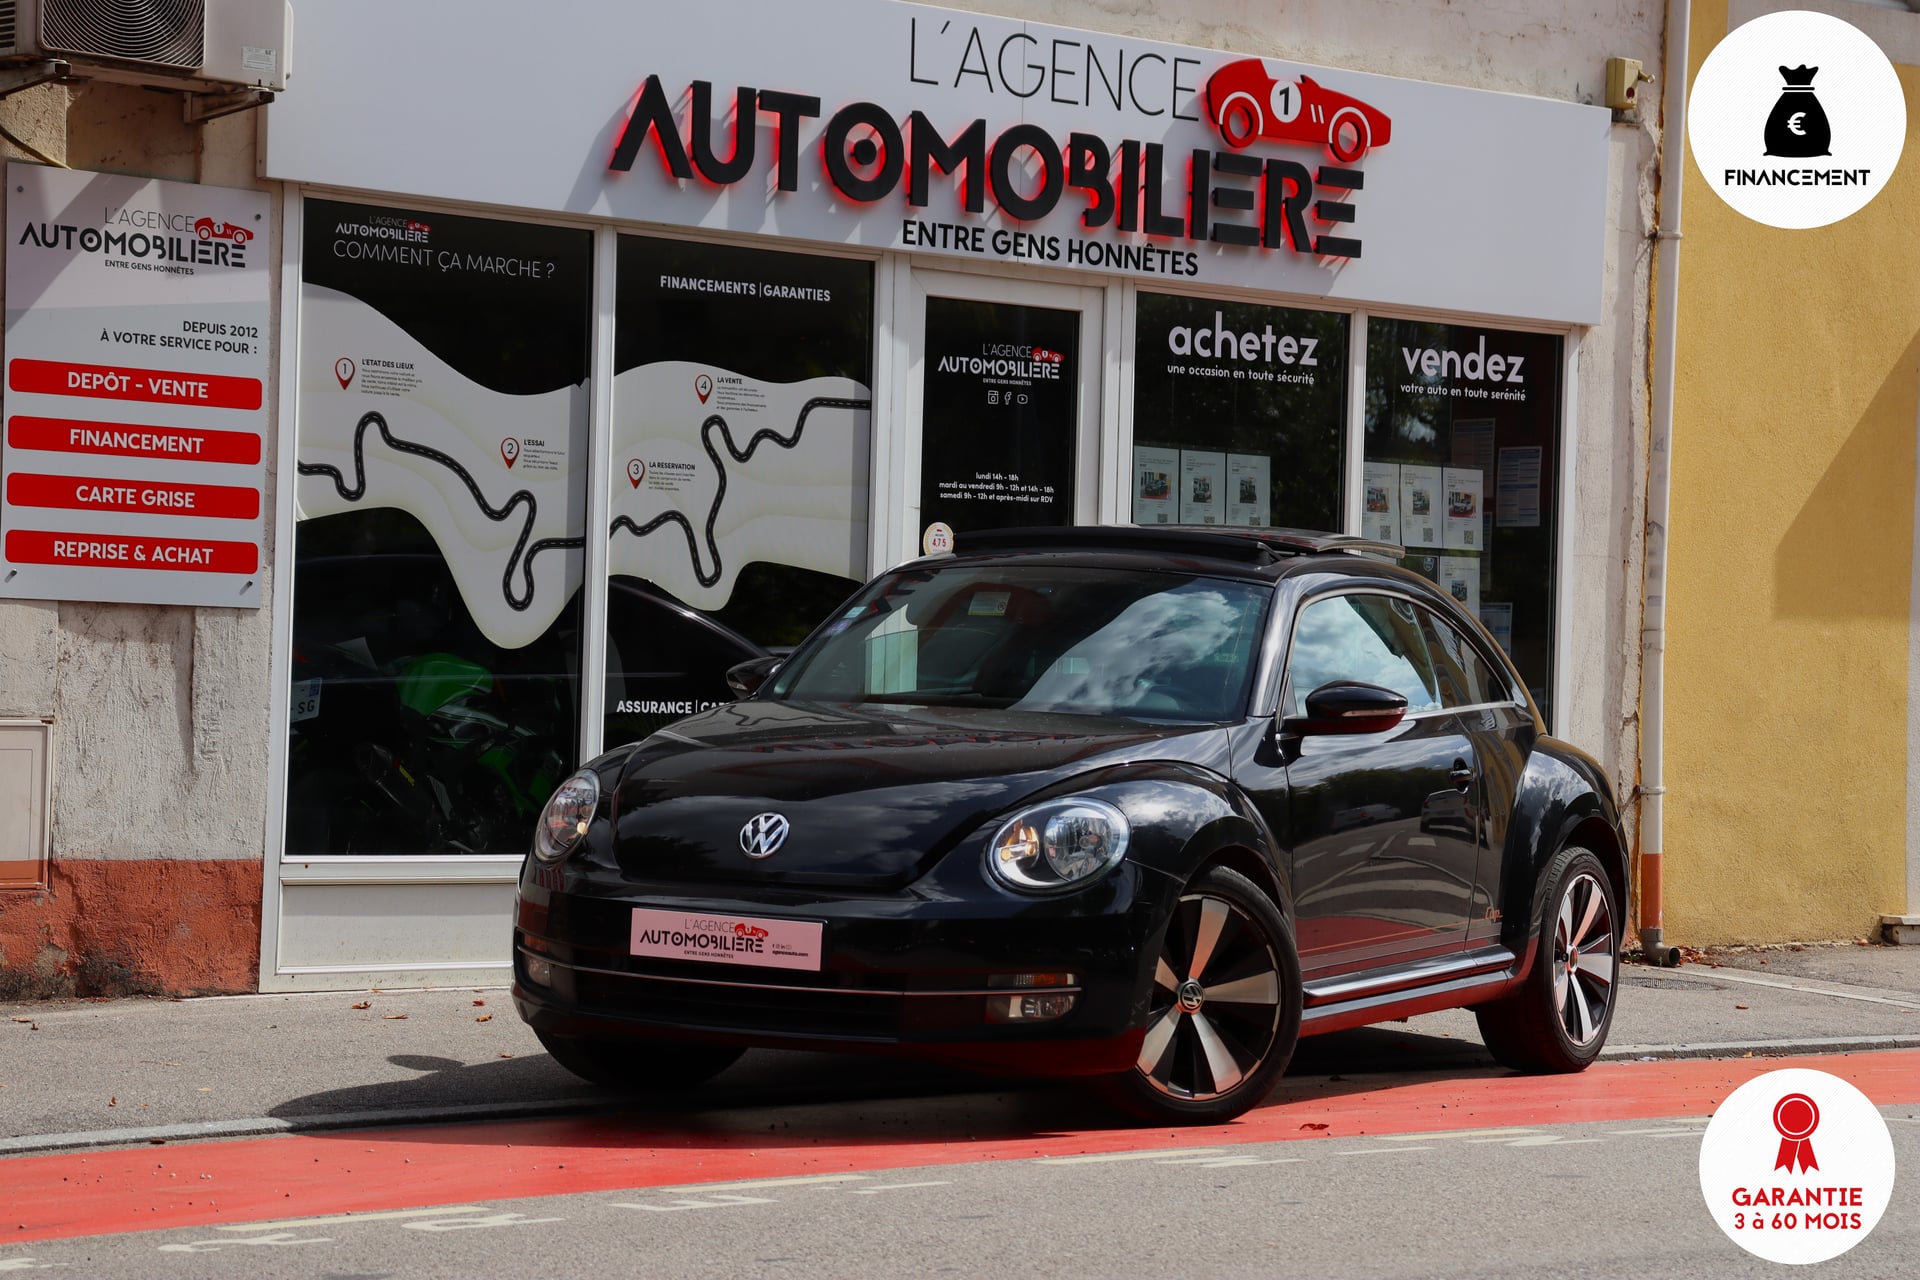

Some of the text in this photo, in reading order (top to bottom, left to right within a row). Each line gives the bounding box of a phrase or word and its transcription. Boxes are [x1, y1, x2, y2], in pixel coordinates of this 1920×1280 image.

[910, 17, 1201, 122] L'AGENCE
[1279, 86, 1290, 116] 1
[105, 206, 195, 234] L'AGENCE
[902, 219, 1199, 277] ENTRE GENS HONNÊTES
[104, 259, 194, 276] ENTRE GENS HONNÊTES
[333, 239, 555, 279] COMMENT ÇA MARCHE ?
[660, 275, 831, 302] FINANCEMENTS GARANTIES
[183, 320, 258, 339] DEPUIS 2012
[1168, 310, 1319, 367] achetez
[100, 328, 110, 342] À
[113, 331, 156, 346] VOTRE
[159, 335, 211, 351] SERVICE
[214, 339, 249, 354] POUR
[982, 343, 1032, 359] L'AGENCE
[1402, 335, 1525, 384] vendez
[342, 363, 347, 375] 1
[382, 360, 394, 368] DES
[395, 361, 414, 370] LIEUX
[724, 377, 743, 385] VENTE
[1167, 364, 1315, 386] une occasion en toute sécurité
[67, 371, 131, 392] DEPÔT
[148, 378, 209, 399] VENTE
[701, 380, 707, 390] 4
[1400, 383, 1424, 394] votre
[1427, 385, 1448, 396] auto
[1450, 388, 1461, 397] en
[1464, 386, 1488, 399] toute
[70, 428, 204, 454] FINANCEMENT
[507, 442, 514, 454] 2
[633, 463, 639, 475] 3
[657, 462, 696, 471] RESERVATION
[975, 472, 991, 480] lundi
[992, 473, 1003, 481] 14h
[939, 481, 958, 489] mardi
[968, 482, 995, 490] vendredi
[1028, 485, 1038, 493] 14h
[75, 485, 195, 509] CARTE GRISE
[940, 491, 963, 499] samedi
[996, 493, 1029, 503] après-midi
[1040, 495, 1054, 503] RDV
[53, 540, 214, 565] REPRISE & ACHAT
[616, 699, 692, 714] ASSURANCE
[684, 918, 735, 934] L'AGENCE
